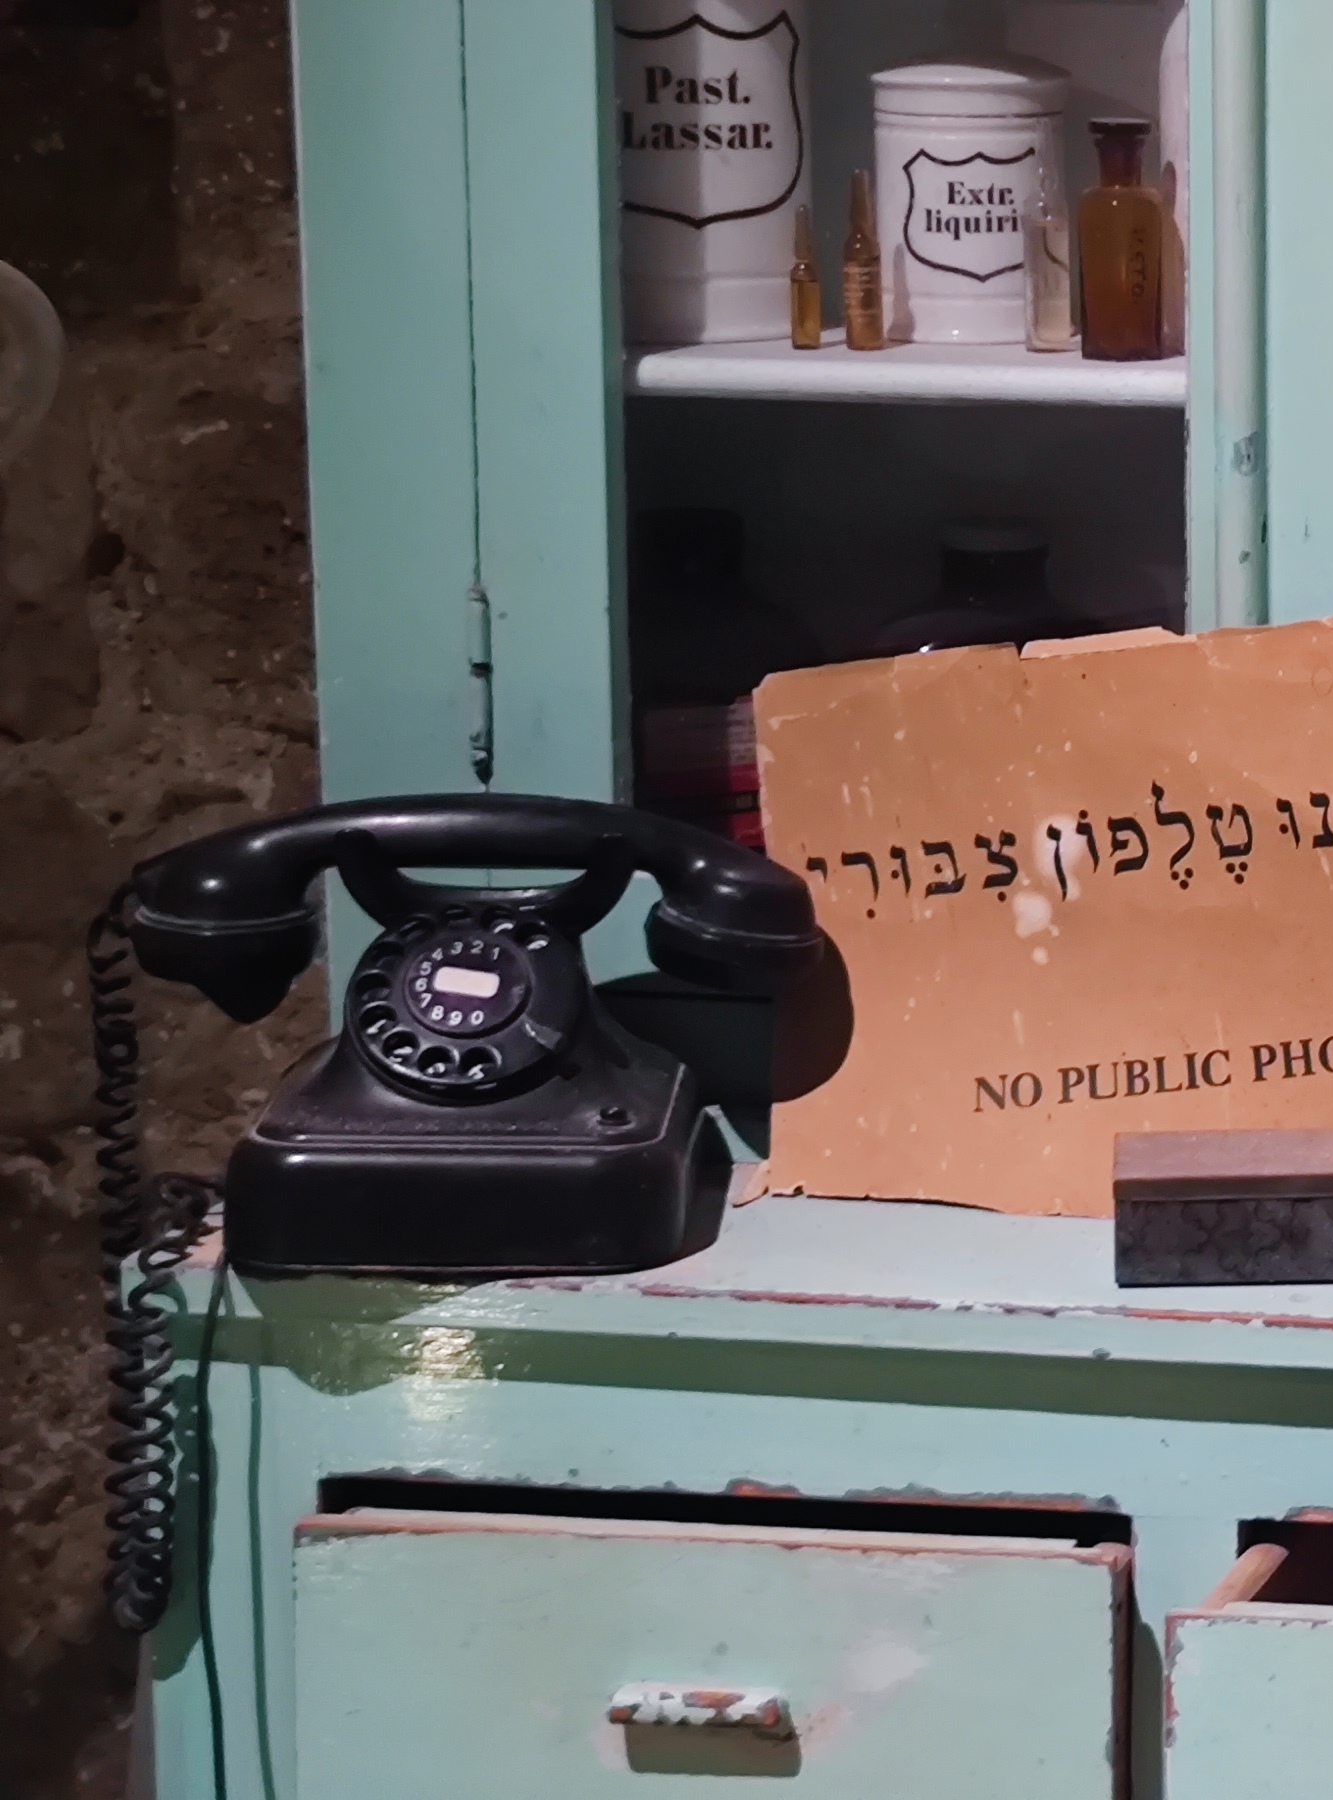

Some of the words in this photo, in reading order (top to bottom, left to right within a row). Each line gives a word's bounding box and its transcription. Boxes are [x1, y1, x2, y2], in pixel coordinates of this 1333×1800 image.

[645, 65, 751, 104] Past.
[622, 111, 773, 150] Lassar.
[947, 181, 1015, 205] Extr.
[925, 208, 1020, 241] liquiri
[431, 948, 444, 961] 4
[451, 941, 464, 954] 3
[471, 940, 484, 954] 2
[491, 947, 501, 960] 1
[420, 962, 432, 975] 5
[415, 978, 428, 991] 6
[420, 993, 432, 1008] 7
[431, 1006, 444, 1021] 8
[449, 1011, 463, 1026] 9
[471, 1010, 485, 1025] 0
[972, 1071, 1043, 1115] NO
[1057, 1048, 1233, 1107] PUBLIC
